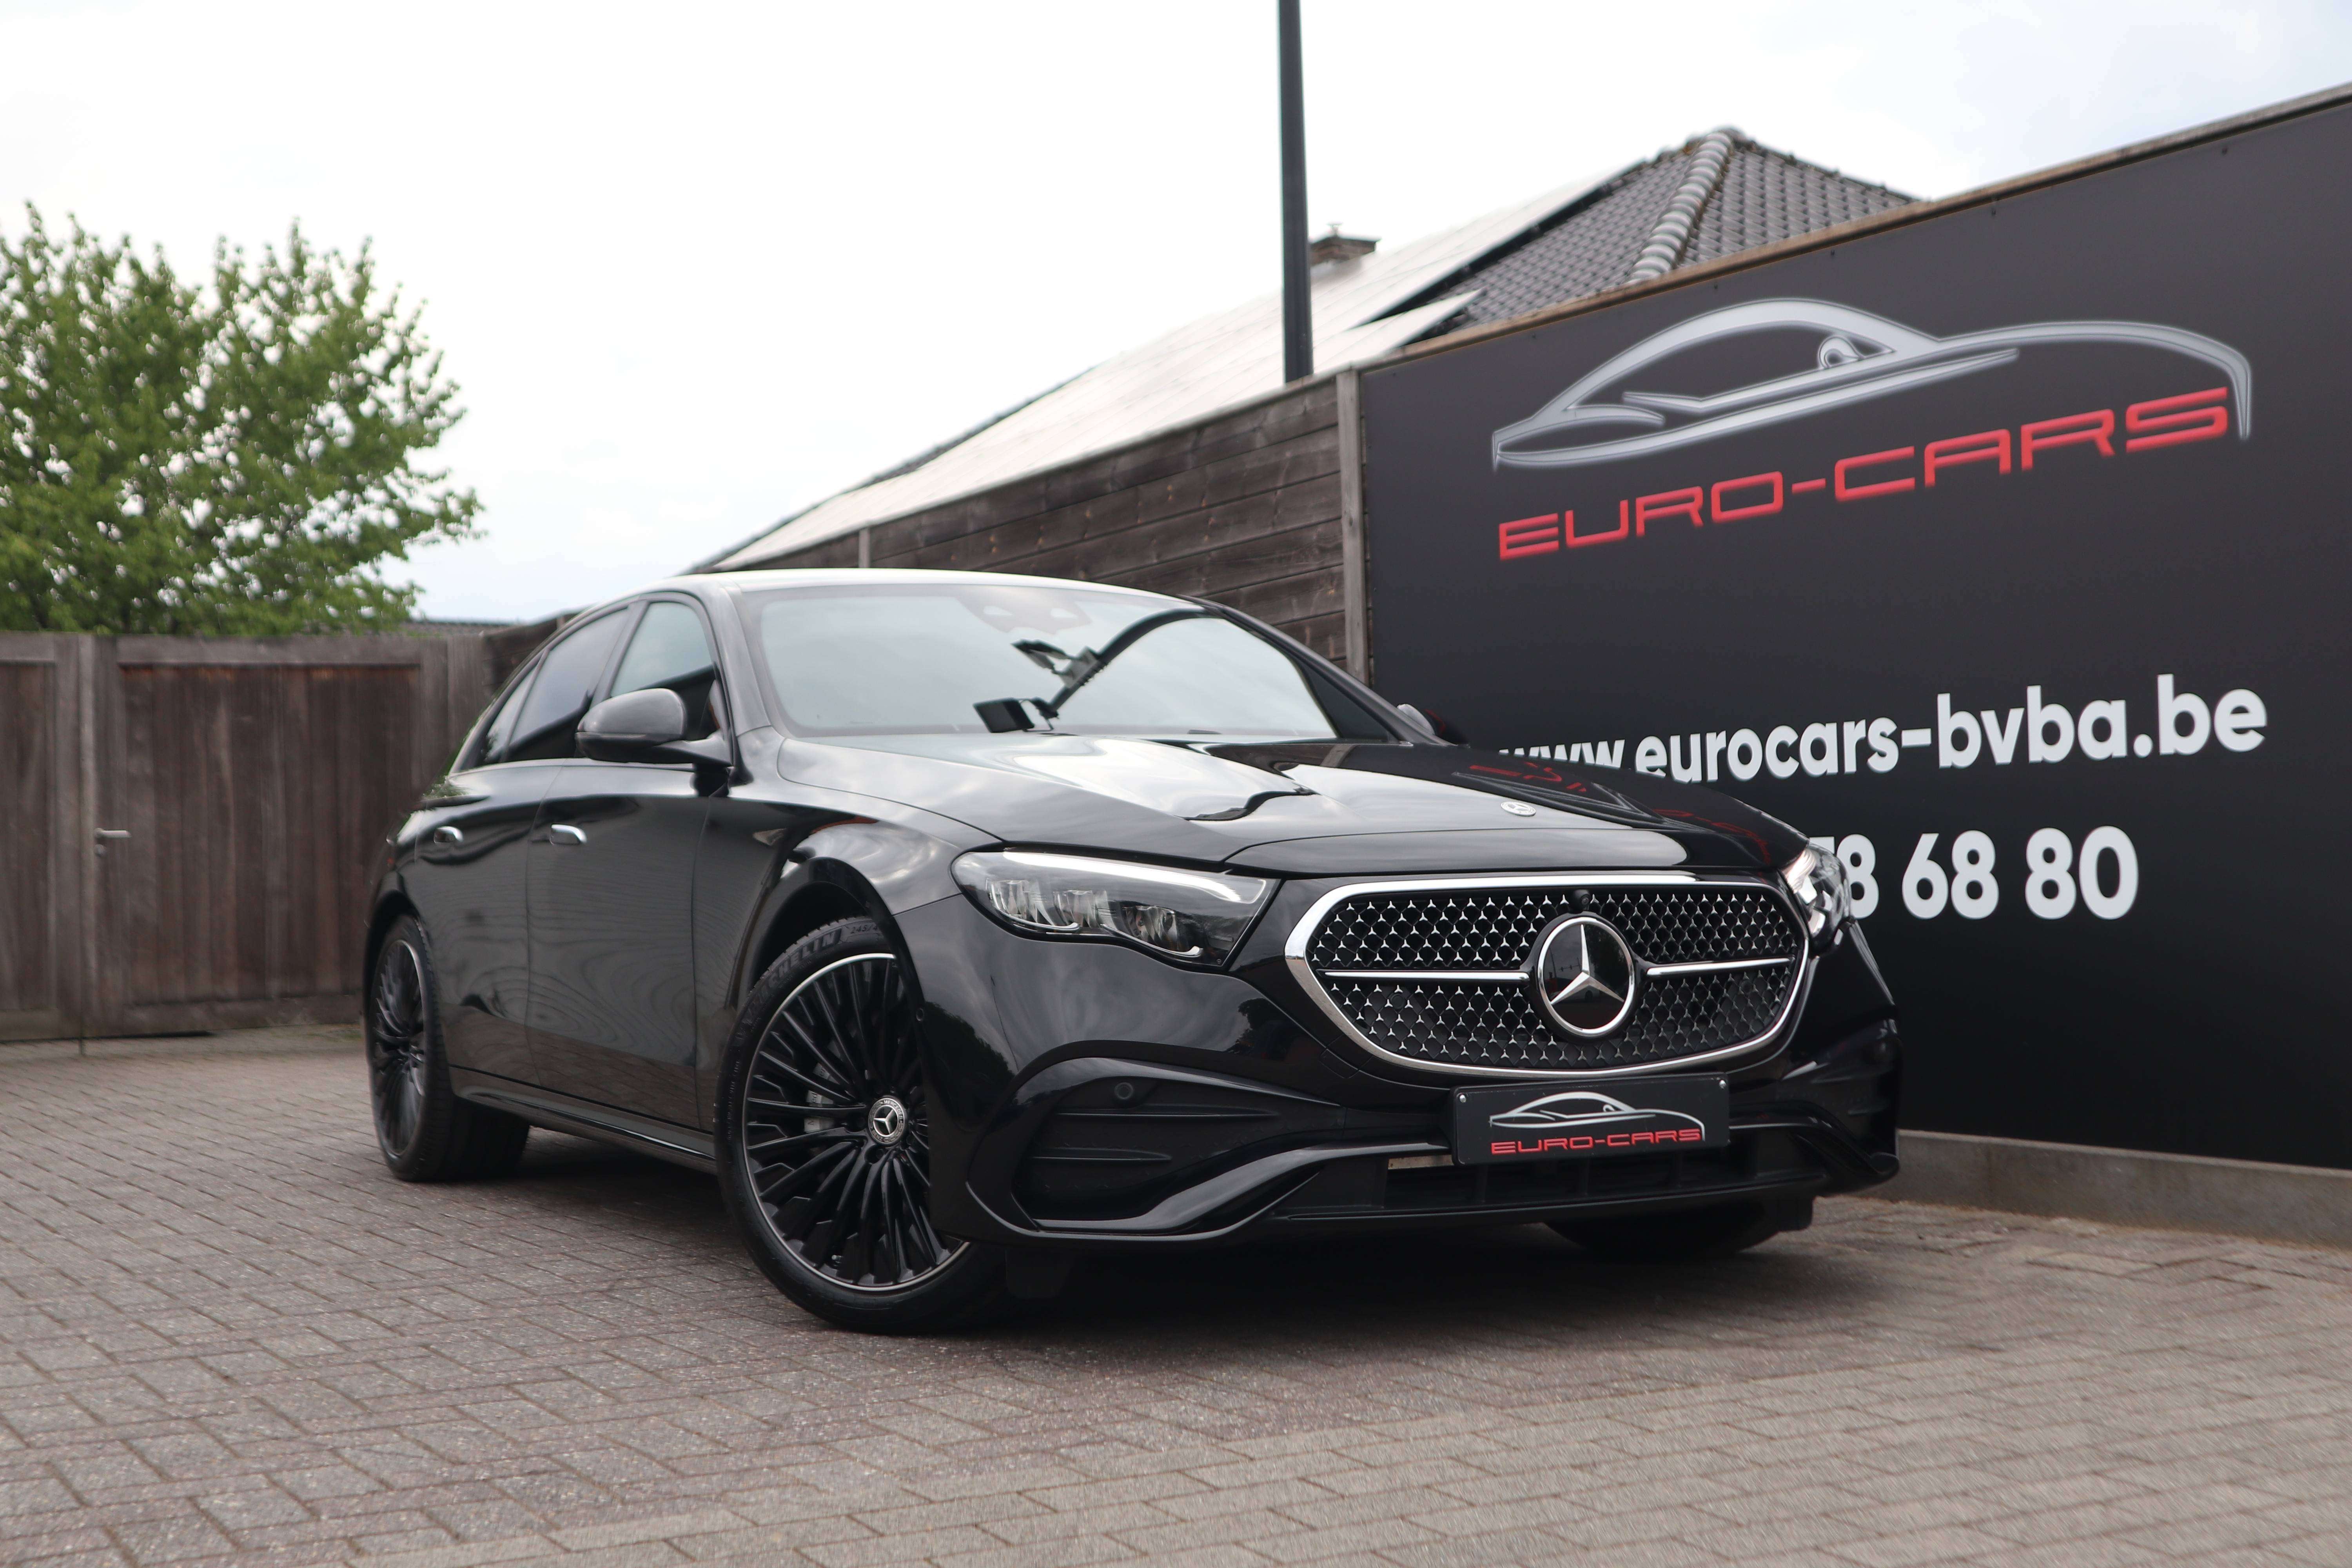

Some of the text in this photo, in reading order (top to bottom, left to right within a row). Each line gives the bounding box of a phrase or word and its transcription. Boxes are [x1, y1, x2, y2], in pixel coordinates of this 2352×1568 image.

[1498, 387, 2229, 561] EURO-CARS
[1498, 674, 2267, 783] weurocars-bvba.be
[1809, 826, 2139, 920] 8 68 80
[850, 924, 878, 934] 245/4
[884, 1100, 903, 1120] MERCEDES
[1491, 1128, 1702, 1155] EURO-CARS
